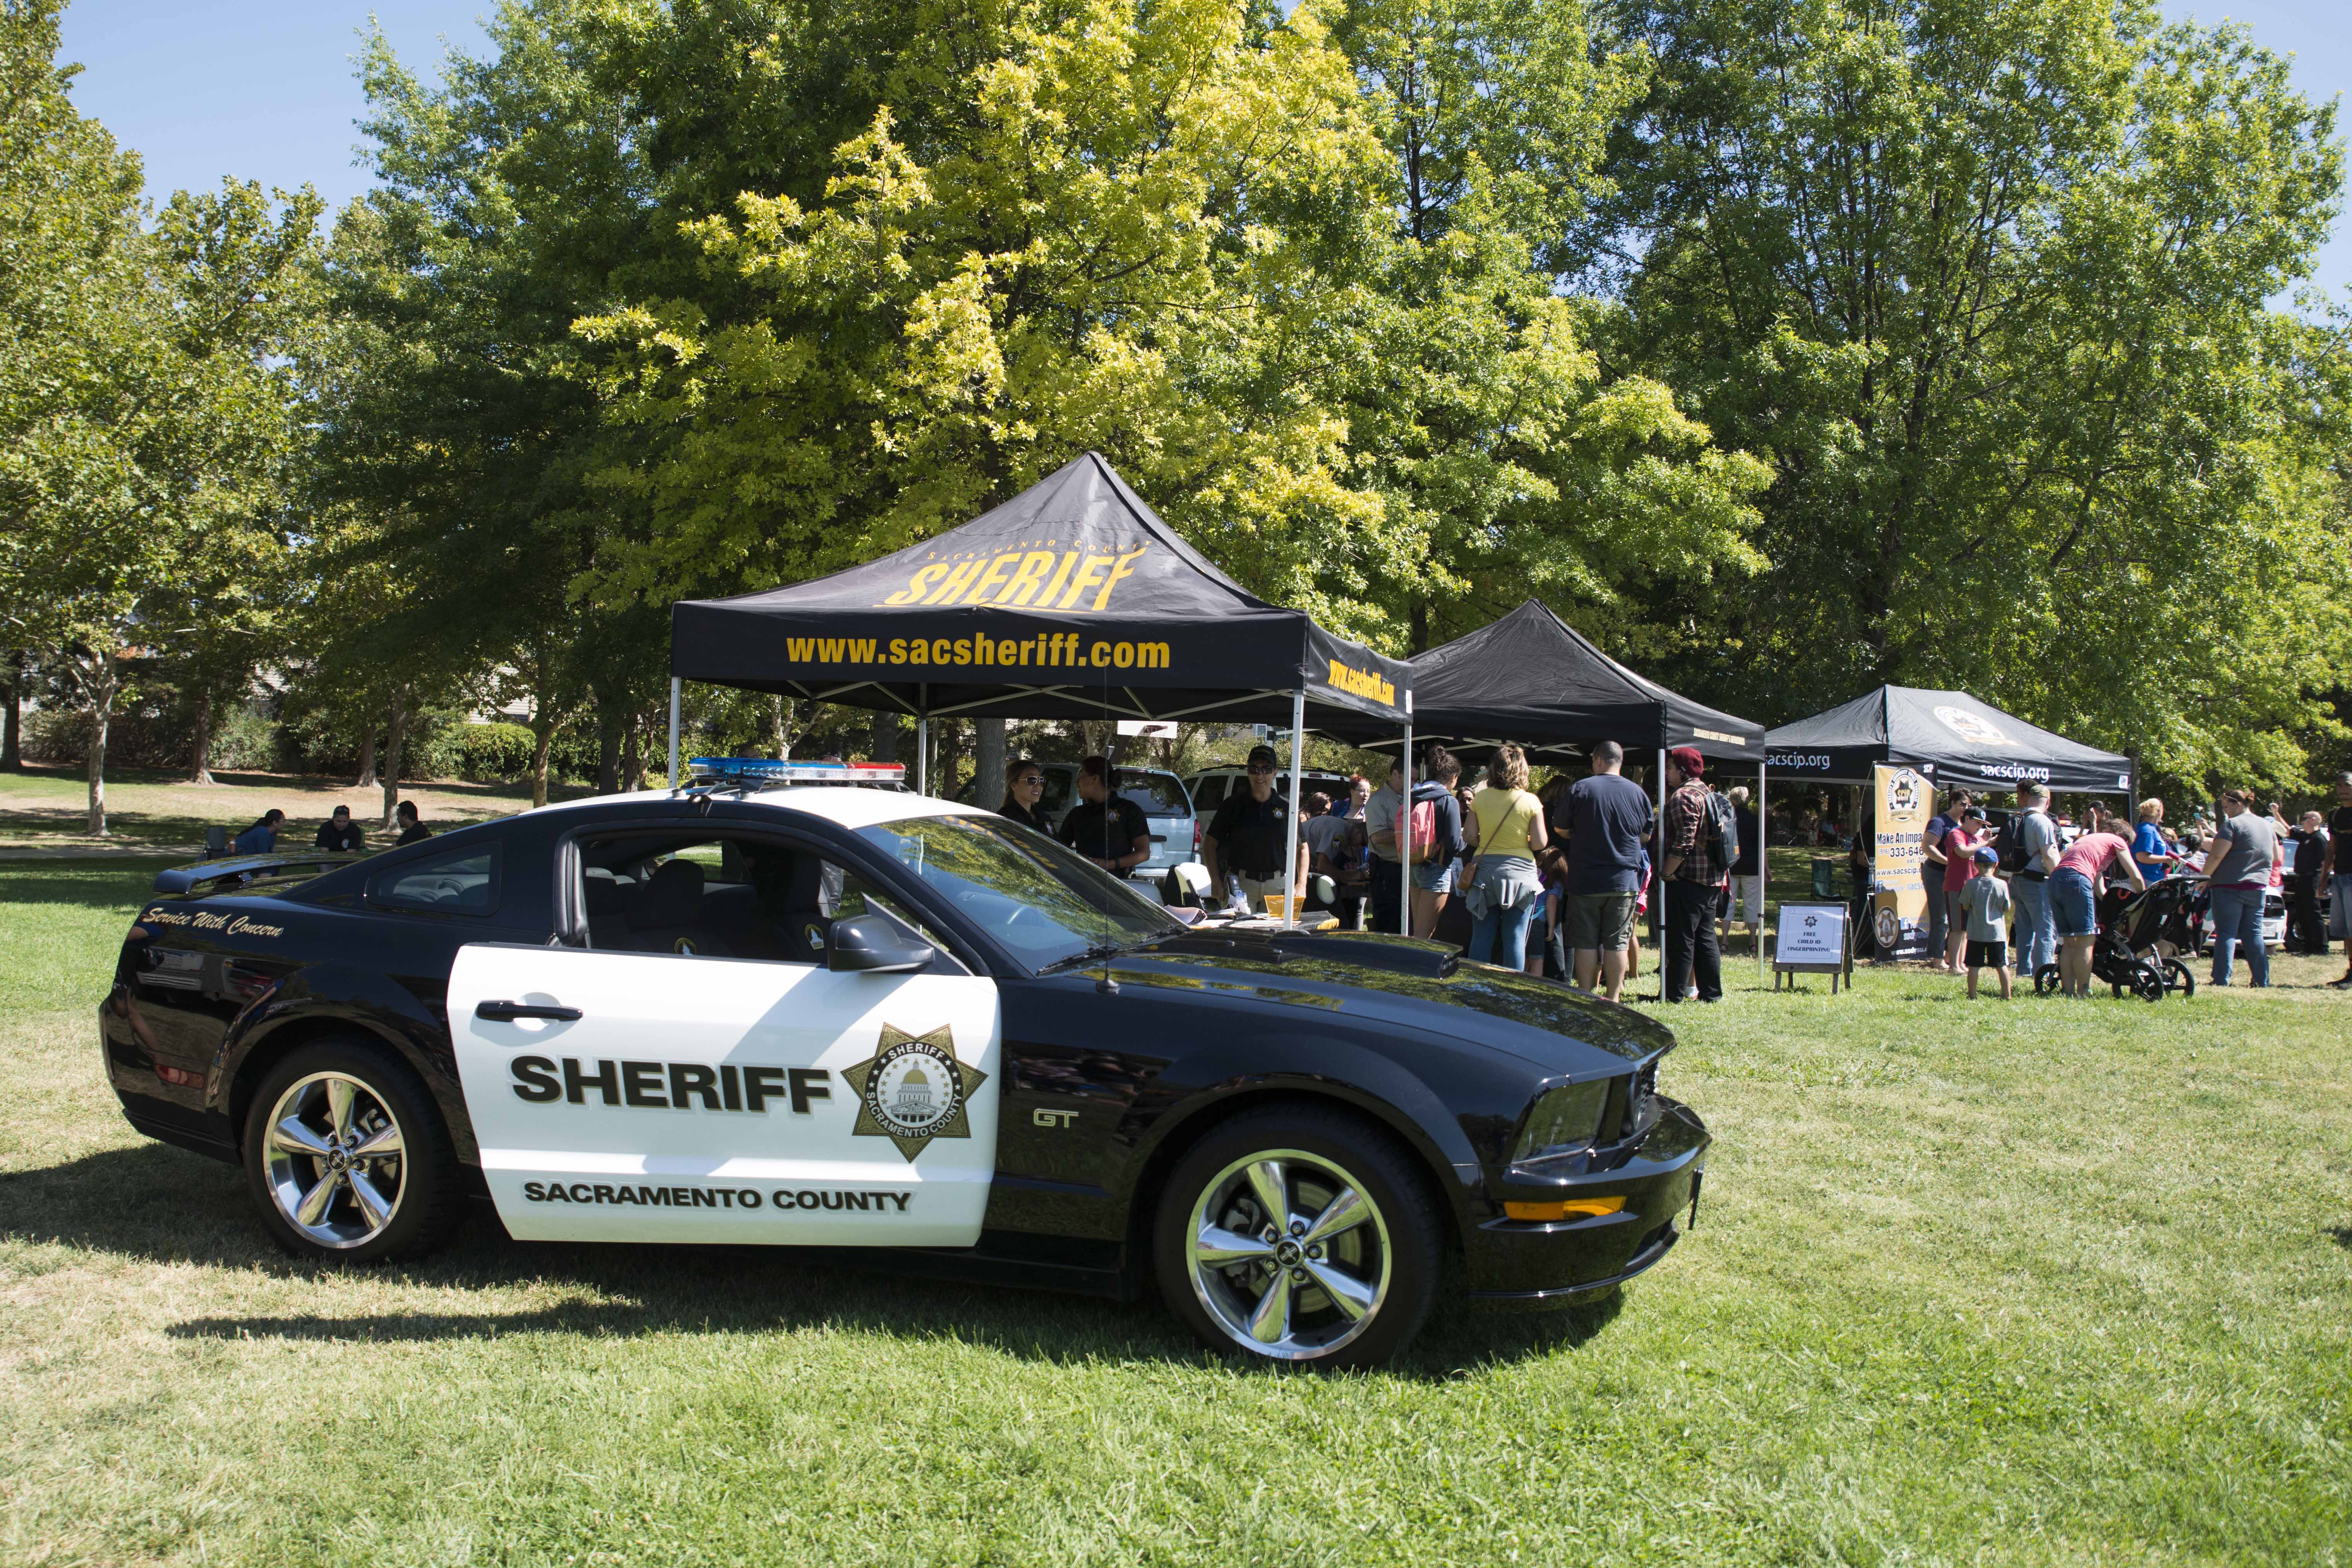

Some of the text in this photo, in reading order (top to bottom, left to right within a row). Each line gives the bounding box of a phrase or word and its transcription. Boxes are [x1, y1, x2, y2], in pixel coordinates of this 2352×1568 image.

[927, 539, 1154, 561] SACRAMENTO COUNTY
[884, 547, 1147, 611] SHERIFF
[786, 632, 1170, 668] www.sacsheriff.com
[1328, 659, 1395, 706] www.sacsheriff.com
[1980, 762, 2050, 783] sacscip.org
[1877, 833, 1894, 845] Make
[1896, 833, 1904, 843] An
[143, 907, 284, 938] Service With Concern
[888, 1043, 946, 1060] SHERIFF
[511, 1055, 832, 1115] SHERIFF
[866, 1092, 962, 1138] SACRAMENTO COUNTY
[1033, 1108, 1079, 1128] GT
[524, 1181, 912, 1212] SACRAMENTO COUNTY
